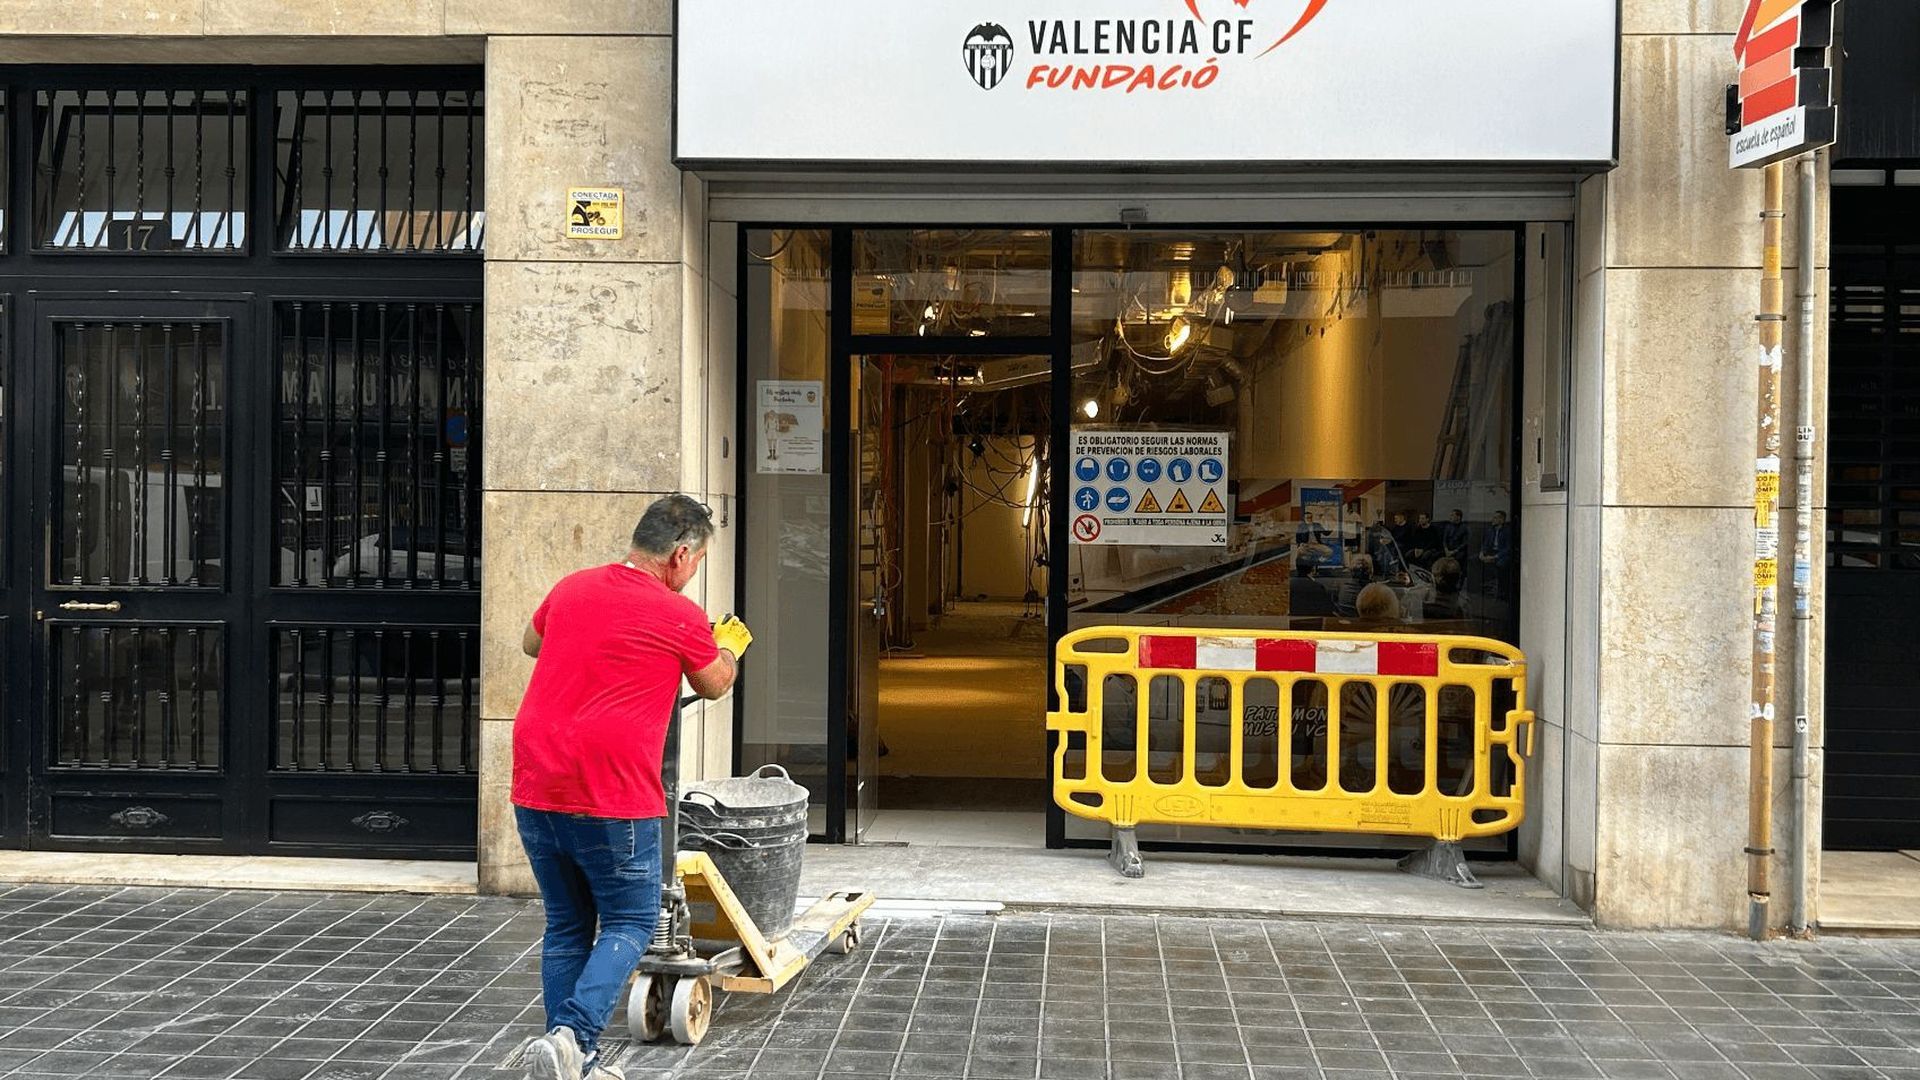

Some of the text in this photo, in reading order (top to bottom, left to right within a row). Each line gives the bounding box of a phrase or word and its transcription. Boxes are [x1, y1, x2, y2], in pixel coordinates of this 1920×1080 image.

[1028, 19, 1254, 54] VALENCIA CF
[1026, 58, 1220, 94] FUNDACIÓ
[1736, 114, 1796, 154] escuela de español
[572, 192, 618, 200] CONECTADA
[123, 225, 155, 251] 17
[571, 227, 618, 235] PROSEGUR
[1078, 436, 1218, 446] ES OBLIGATORIO SEGUIR LAS NORMAS
[1076, 446, 1223, 456] DE PREVENCION DE RIESGOS LABORALES
